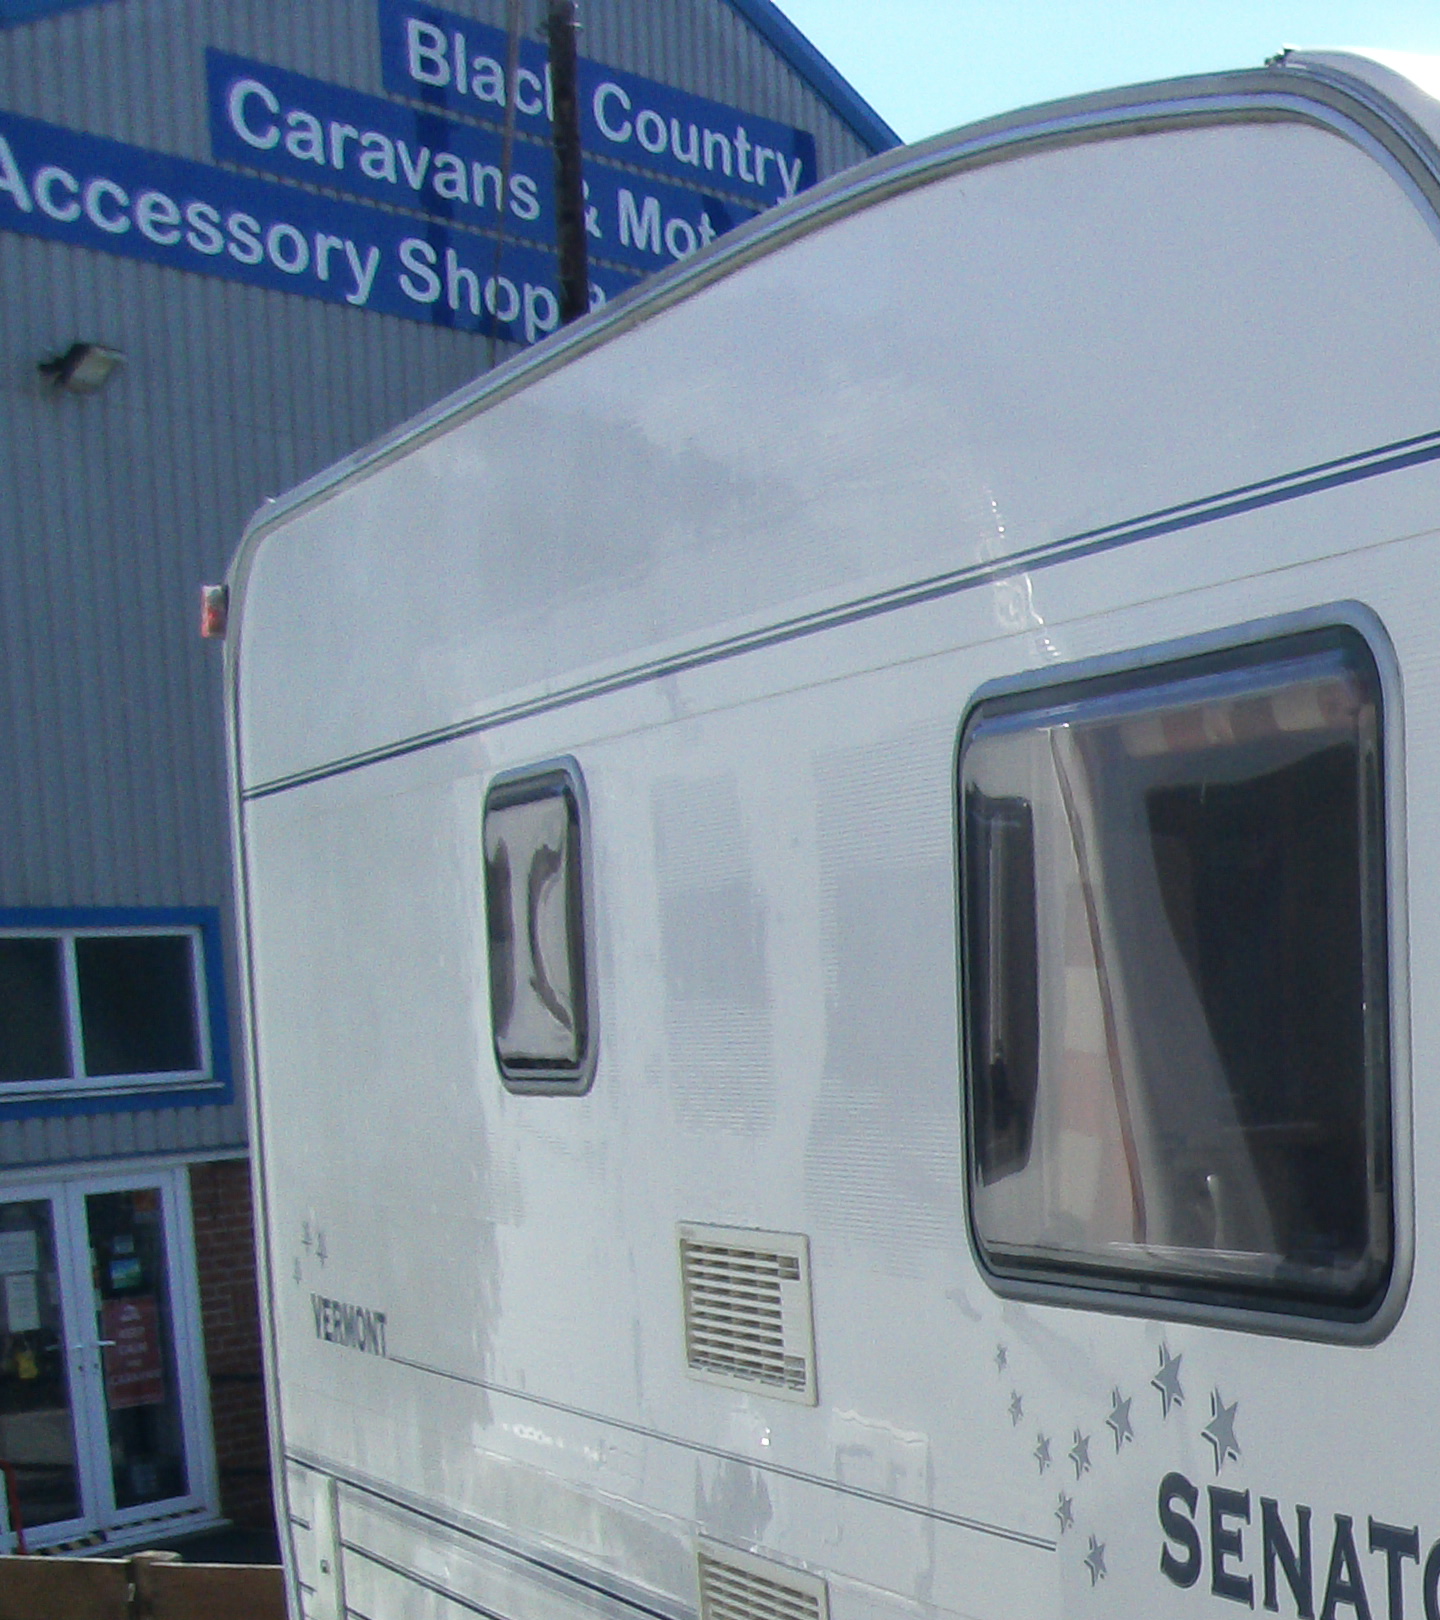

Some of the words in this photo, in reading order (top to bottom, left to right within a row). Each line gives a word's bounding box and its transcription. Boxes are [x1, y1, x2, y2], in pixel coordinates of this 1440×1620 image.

[228, 78, 541, 221] Caravans
[593, 81, 802, 205] Country
[399, 237, 560, 345] Shop
[309, 1292, 387, 1357] VERMONT
